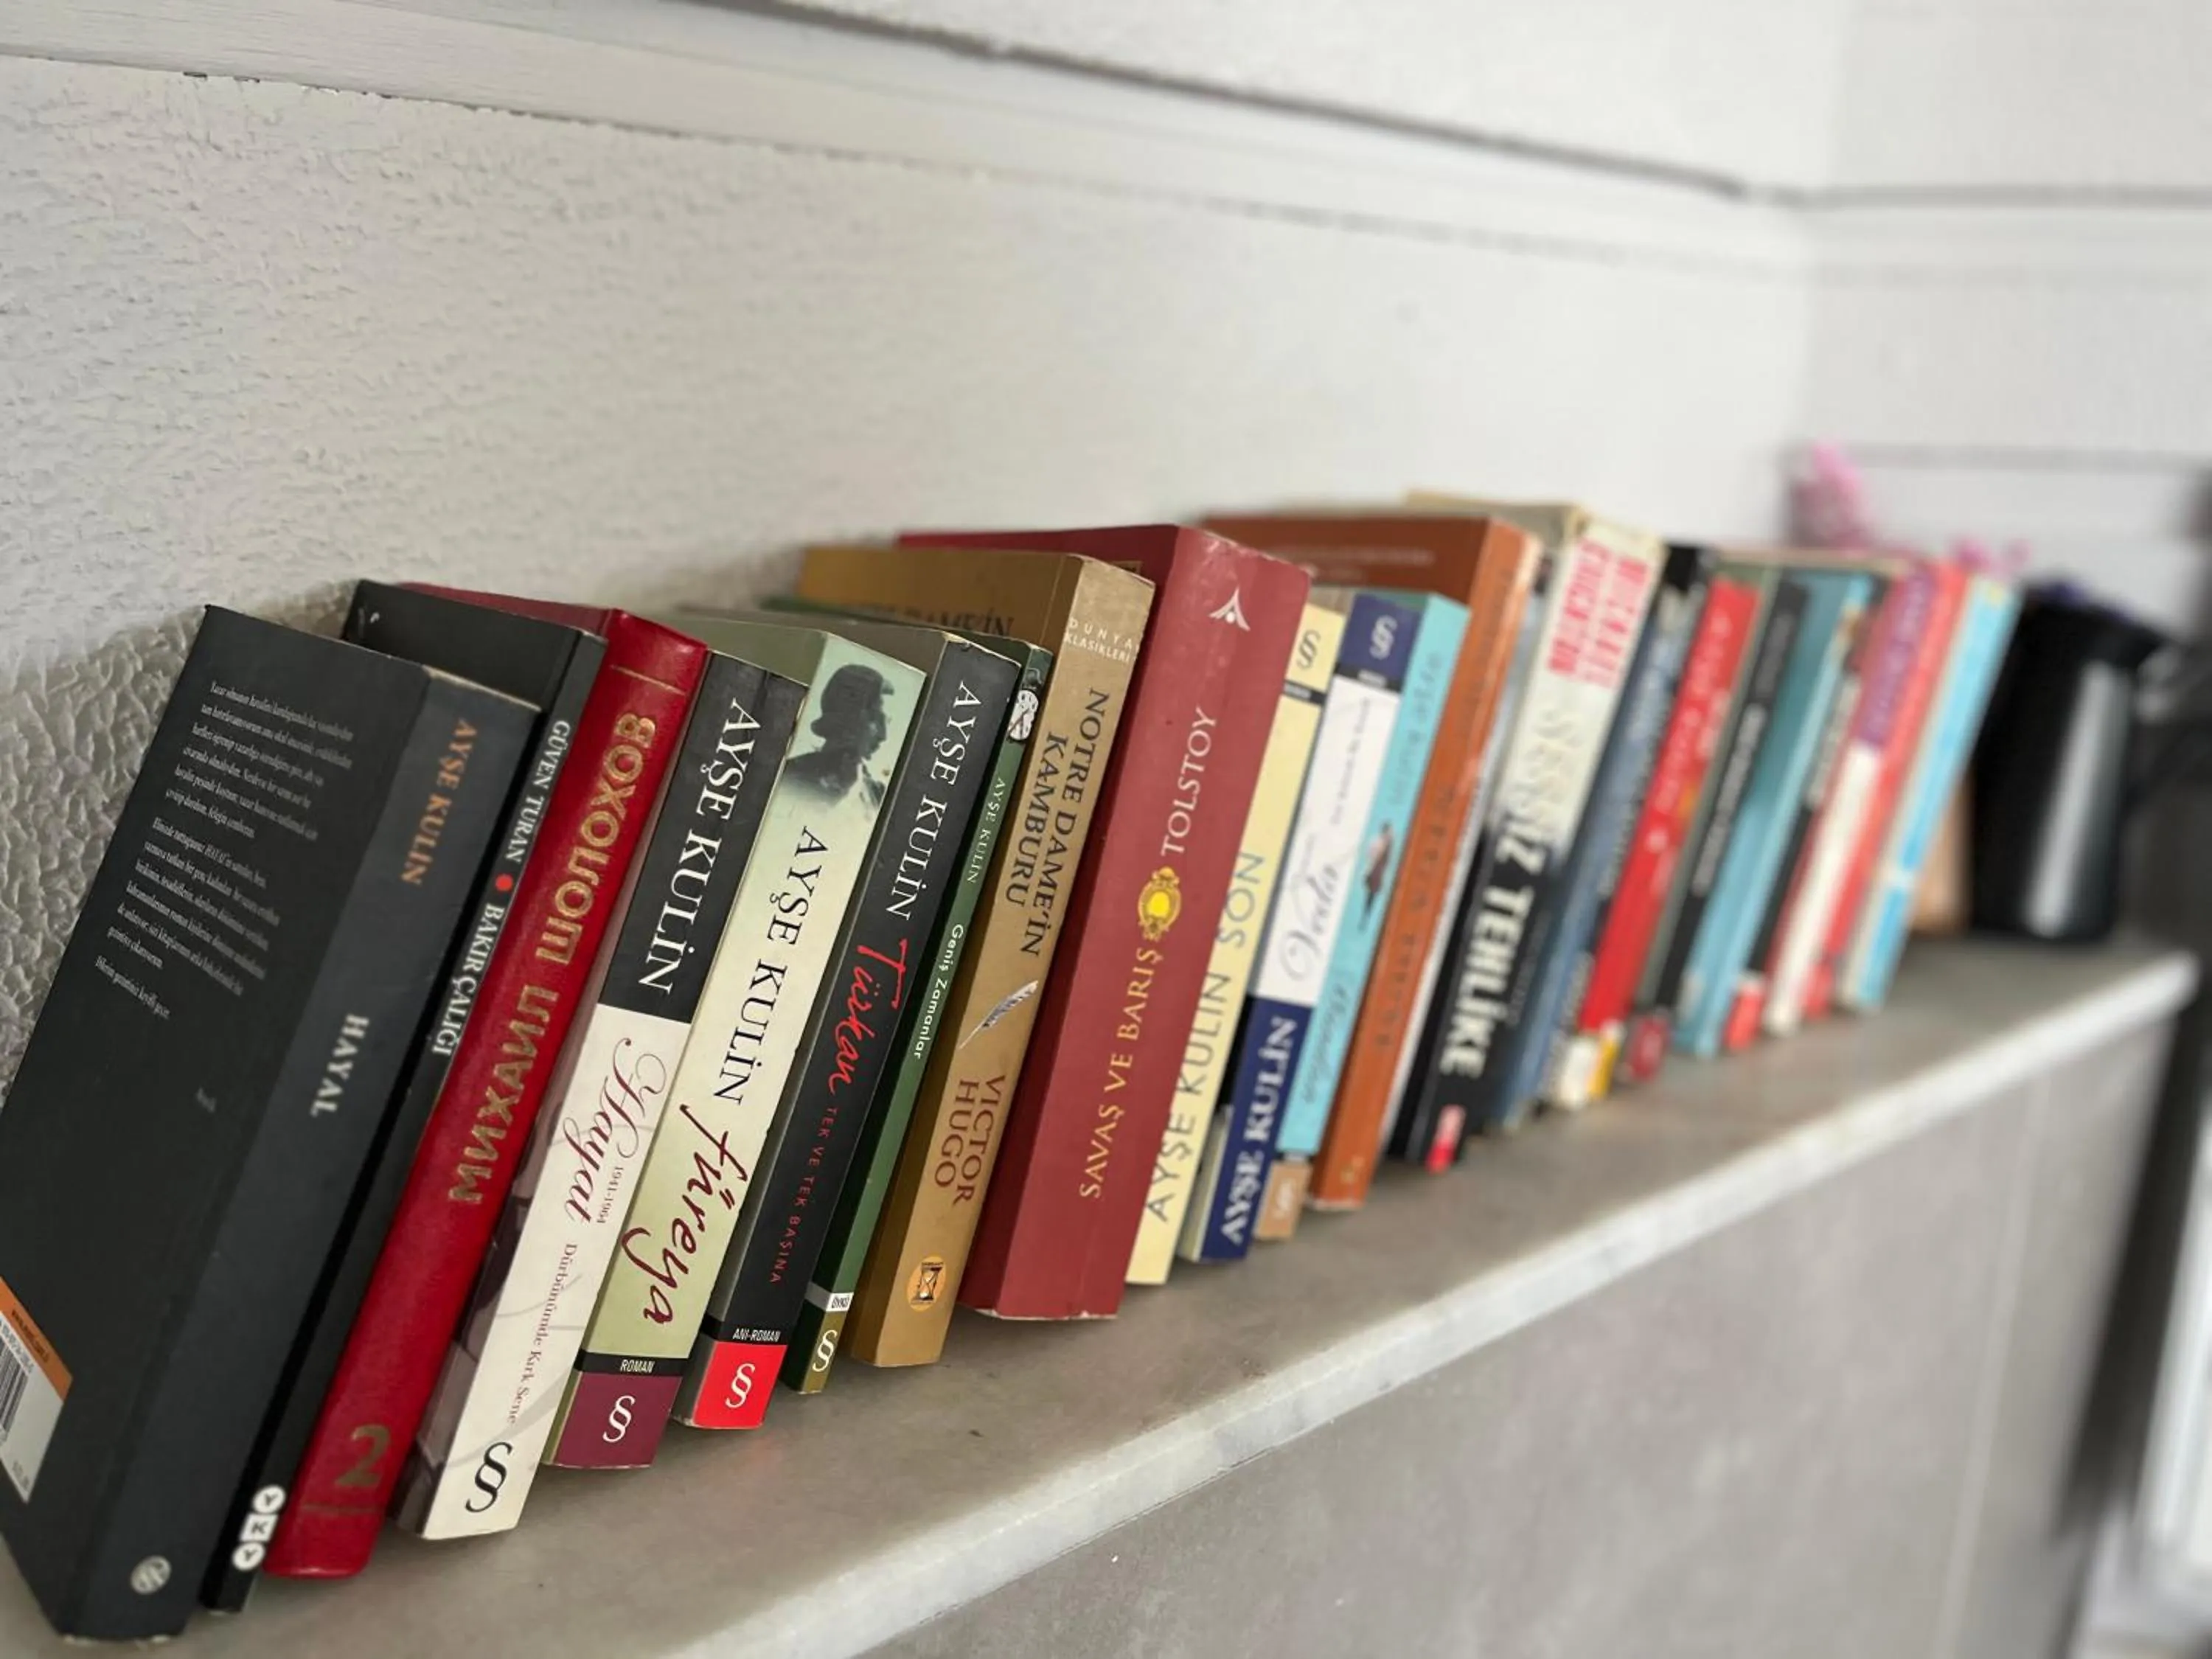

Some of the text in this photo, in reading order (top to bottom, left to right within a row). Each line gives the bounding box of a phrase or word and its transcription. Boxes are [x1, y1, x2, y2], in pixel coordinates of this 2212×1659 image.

[437, 718, 478, 790] AYŞE
[533, 720, 571, 789] GÜVEN
[886, 681, 982, 921] AYŞE KULİN
[986, 777, 1006, 823] AYŞE
[1062, 687, 1110, 804] NOTRE
[1161, 707, 1217, 858] TOLSTOY
[505, 796, 546, 863] TURAN
[638, 698, 761, 994] AYŞE KULİN
[1006, 731, 1068, 907] KAMBURU
[449, 712, 655, 1205] МИХАИЛ ШОЛОХОВ
[463, 902, 505, 973] BAKIR
[713, 825, 829, 1105] AYŞE KULİN
[914, 924, 964, 1060] Geniş Zamanlar
[310, 1014, 369, 1116] HAYAL
[827, 939, 908, 1096] Türkan
[1079, 947, 1164, 1199] SAVAŞ VE BARIŞ
[1146, 1113, 1196, 1222] AYŞE
[1217, 852, 1265, 949] SON
[563, 1037, 667, 1222] Hayat
[597, 1166, 624, 1224] 1941-1964
[769, 1107, 838, 1283] TEK VE TEK BAŞINA
[934, 1079, 980, 1189] HUGO
[953, 1074, 1006, 1206] VICTOR
[534, 1243, 577, 1346] Dürbünümde
[620, 1359, 655, 1374] ROMAN
[335, 1424, 390, 1486] 2
